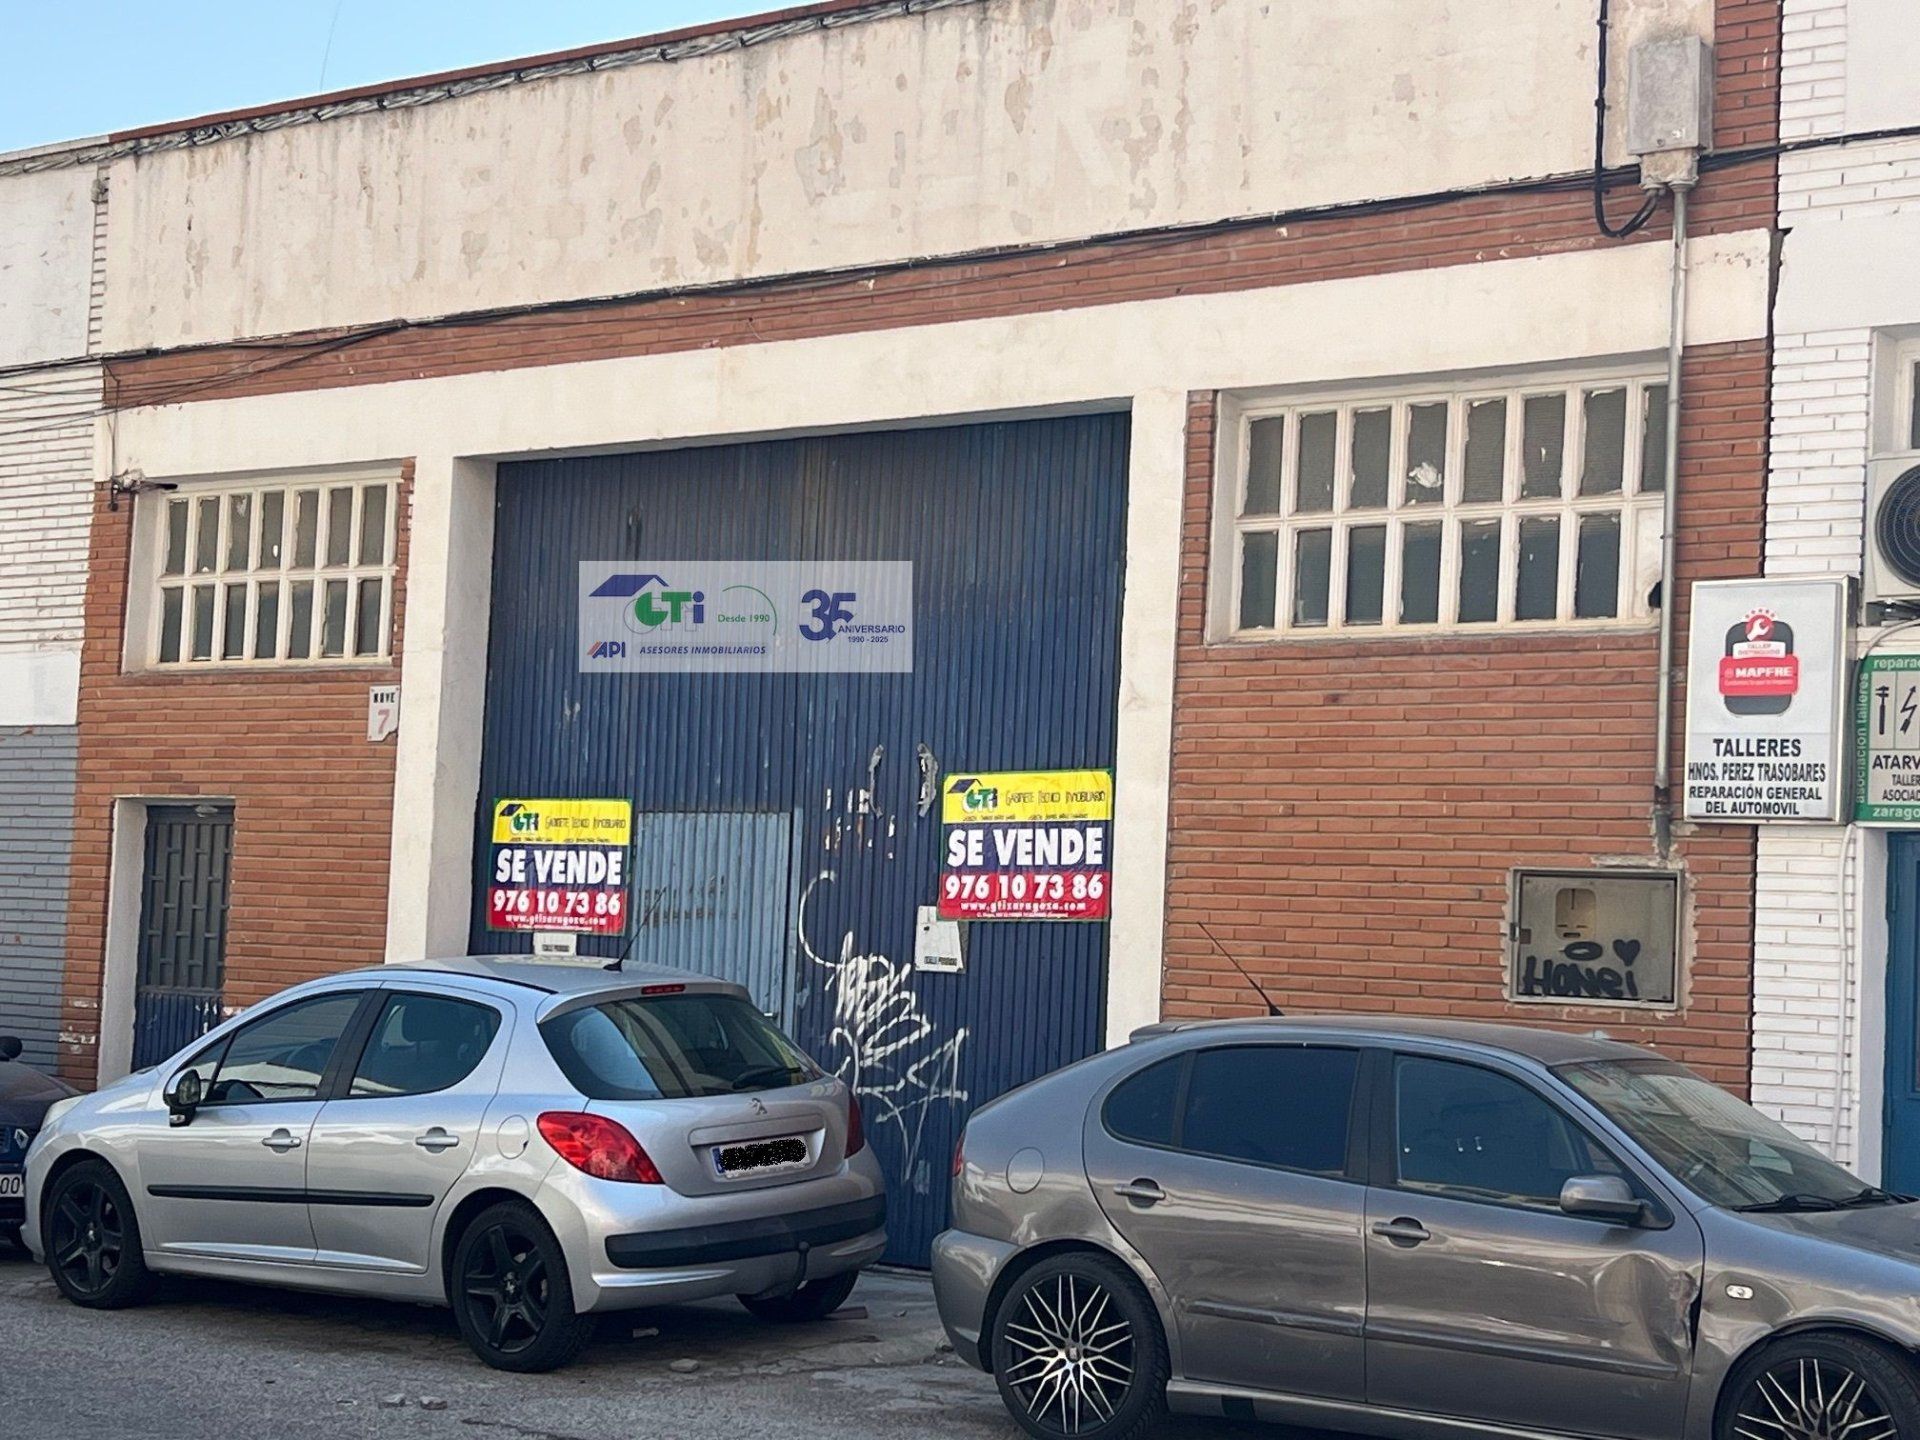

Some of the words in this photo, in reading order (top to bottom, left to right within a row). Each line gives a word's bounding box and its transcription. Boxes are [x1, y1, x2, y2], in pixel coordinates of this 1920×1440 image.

[1735, 665, 1793, 678] MAPFRE
[378, 708, 390, 734] 7
[1713, 738, 1801, 757] TALLERES
[1688, 762, 1719, 781] HNOS.
[1721, 762, 1754, 781] PEREZ
[1757, 763, 1826, 783] TRASOBARES
[1689, 783, 1763, 799] REPARACIÓN
[1766, 786, 1822, 800] GENERAL
[1705, 801, 1727, 814] DEL
[1730, 801, 1800, 815] AUTOMOVIL
[947, 828, 984, 867] SE
[993, 827, 1103, 866] VENDE
[496, 848, 527, 883] SE
[533, 849, 623, 885] VENDE
[945, 874, 990, 900] 976
[998, 875, 1026, 899] 10
[1034, 874, 1065, 900] 73
[1072, 873, 1104, 900] 86
[494, 889, 530, 912] 976
[536, 891, 559, 913] 10
[565, 892, 590, 914] 73
[595, 892, 621, 916] 86
